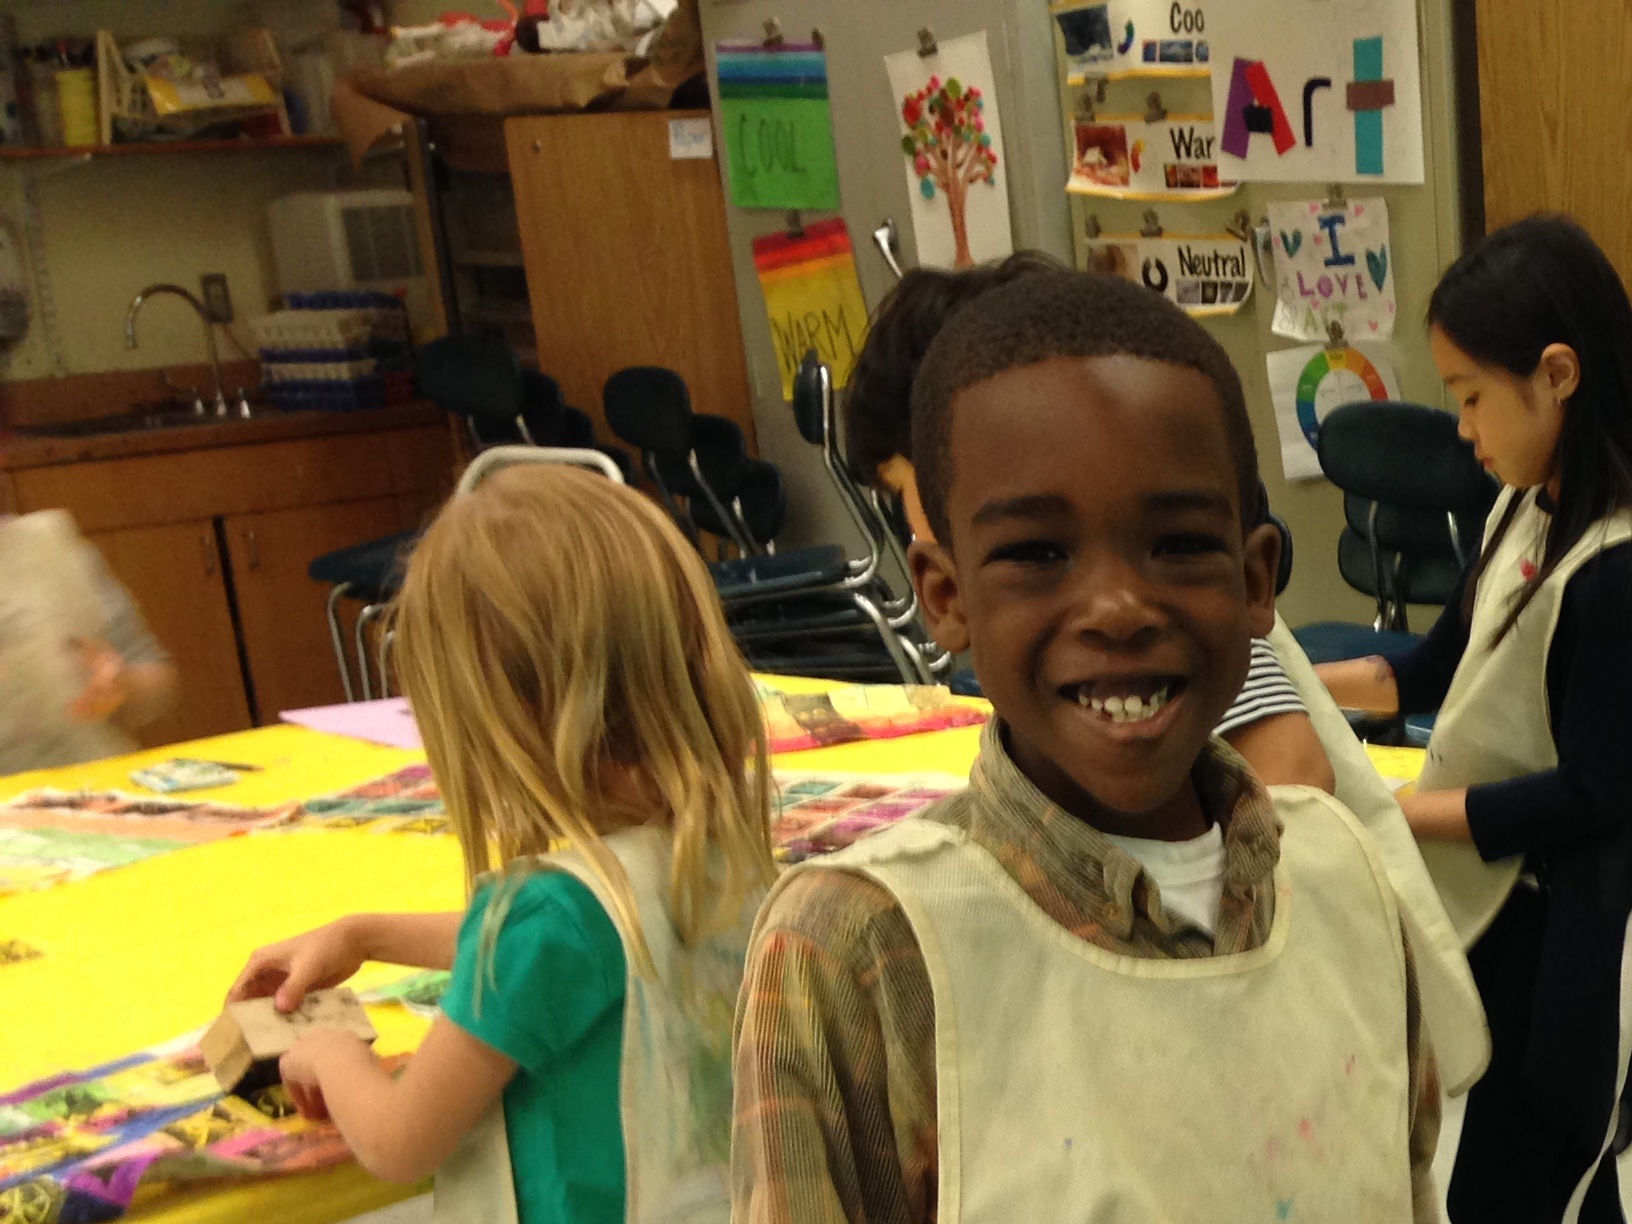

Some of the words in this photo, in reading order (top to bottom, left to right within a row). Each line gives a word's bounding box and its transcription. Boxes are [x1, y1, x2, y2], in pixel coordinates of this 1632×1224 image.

[1221, 36, 1396, 175] Art
[738, 113, 807, 177] COOL
[1177, 244, 1246, 278] Neutral
[1318, 214, 1355, 268] I
[1296, 270, 1369, 300] LOVE
[770, 303, 859, 375] WARM
